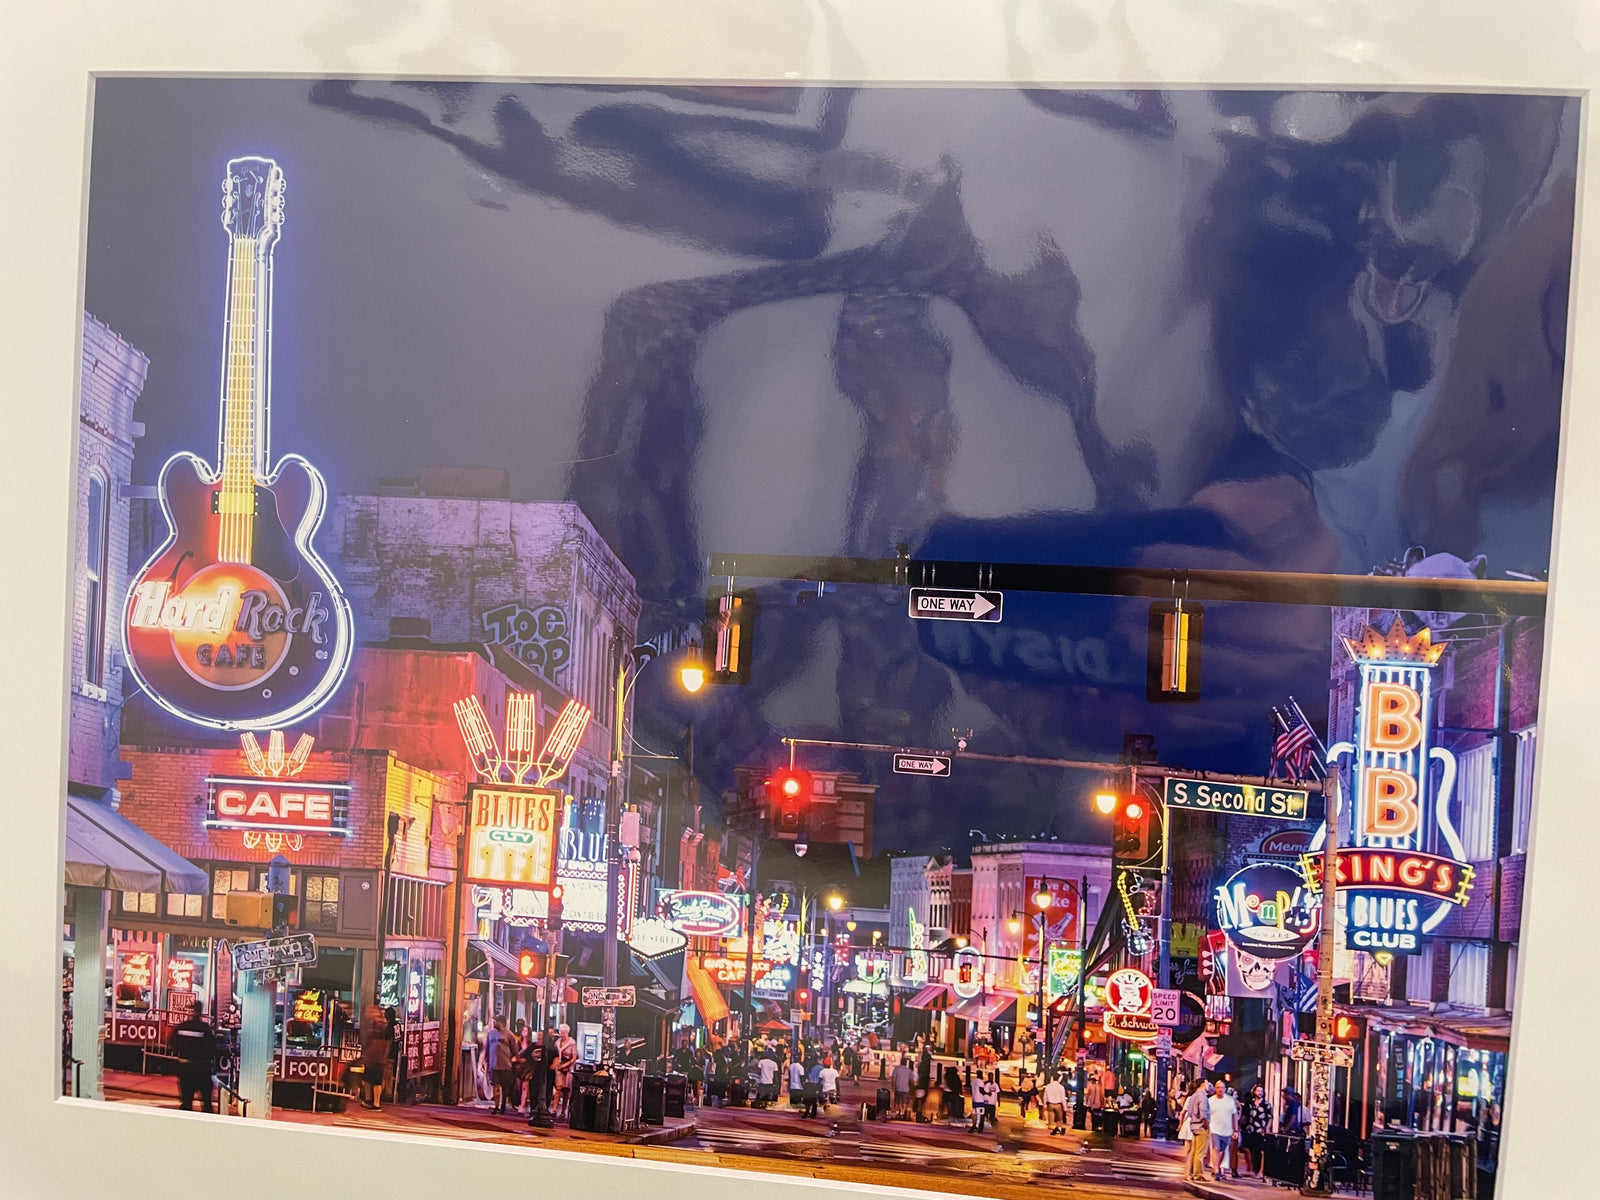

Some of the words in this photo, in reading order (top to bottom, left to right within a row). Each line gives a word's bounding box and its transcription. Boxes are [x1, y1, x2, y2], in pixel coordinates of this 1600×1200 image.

[132, 581, 236, 630] Hard
[235, 590, 329, 645] Rock
[921, 598, 945, 610] ONE
[950, 599, 975, 612] WAY
[196, 643, 267, 670] CAFE
[900, 760, 916, 769] ONE
[918, 761, 934, 770] WAY
[217, 789, 332, 820] CAFE
[1173, 782, 1192, 806] S.
[1196, 784, 1266, 813] Second
[1270, 792, 1299, 816] St.
[475, 793, 551, 833] BLUES
[1321, 854, 1453, 893] KING'S
[1033, 880, 1060, 890] Hve
[1031, 892, 1071, 908] Cke
[1352, 895, 1419, 931] BLUES
[1353, 930, 1416, 949] CLUB
[733, 959, 771, 971] PAACE
[1153, 992, 1178, 1000] SPEED
[1120, 1014, 1159, 1030] Schwa
[1153, 1007, 1176, 1021] 20
[119, 1024, 157, 1040] FOOD
[289, 1061, 328, 1077] FOOD
